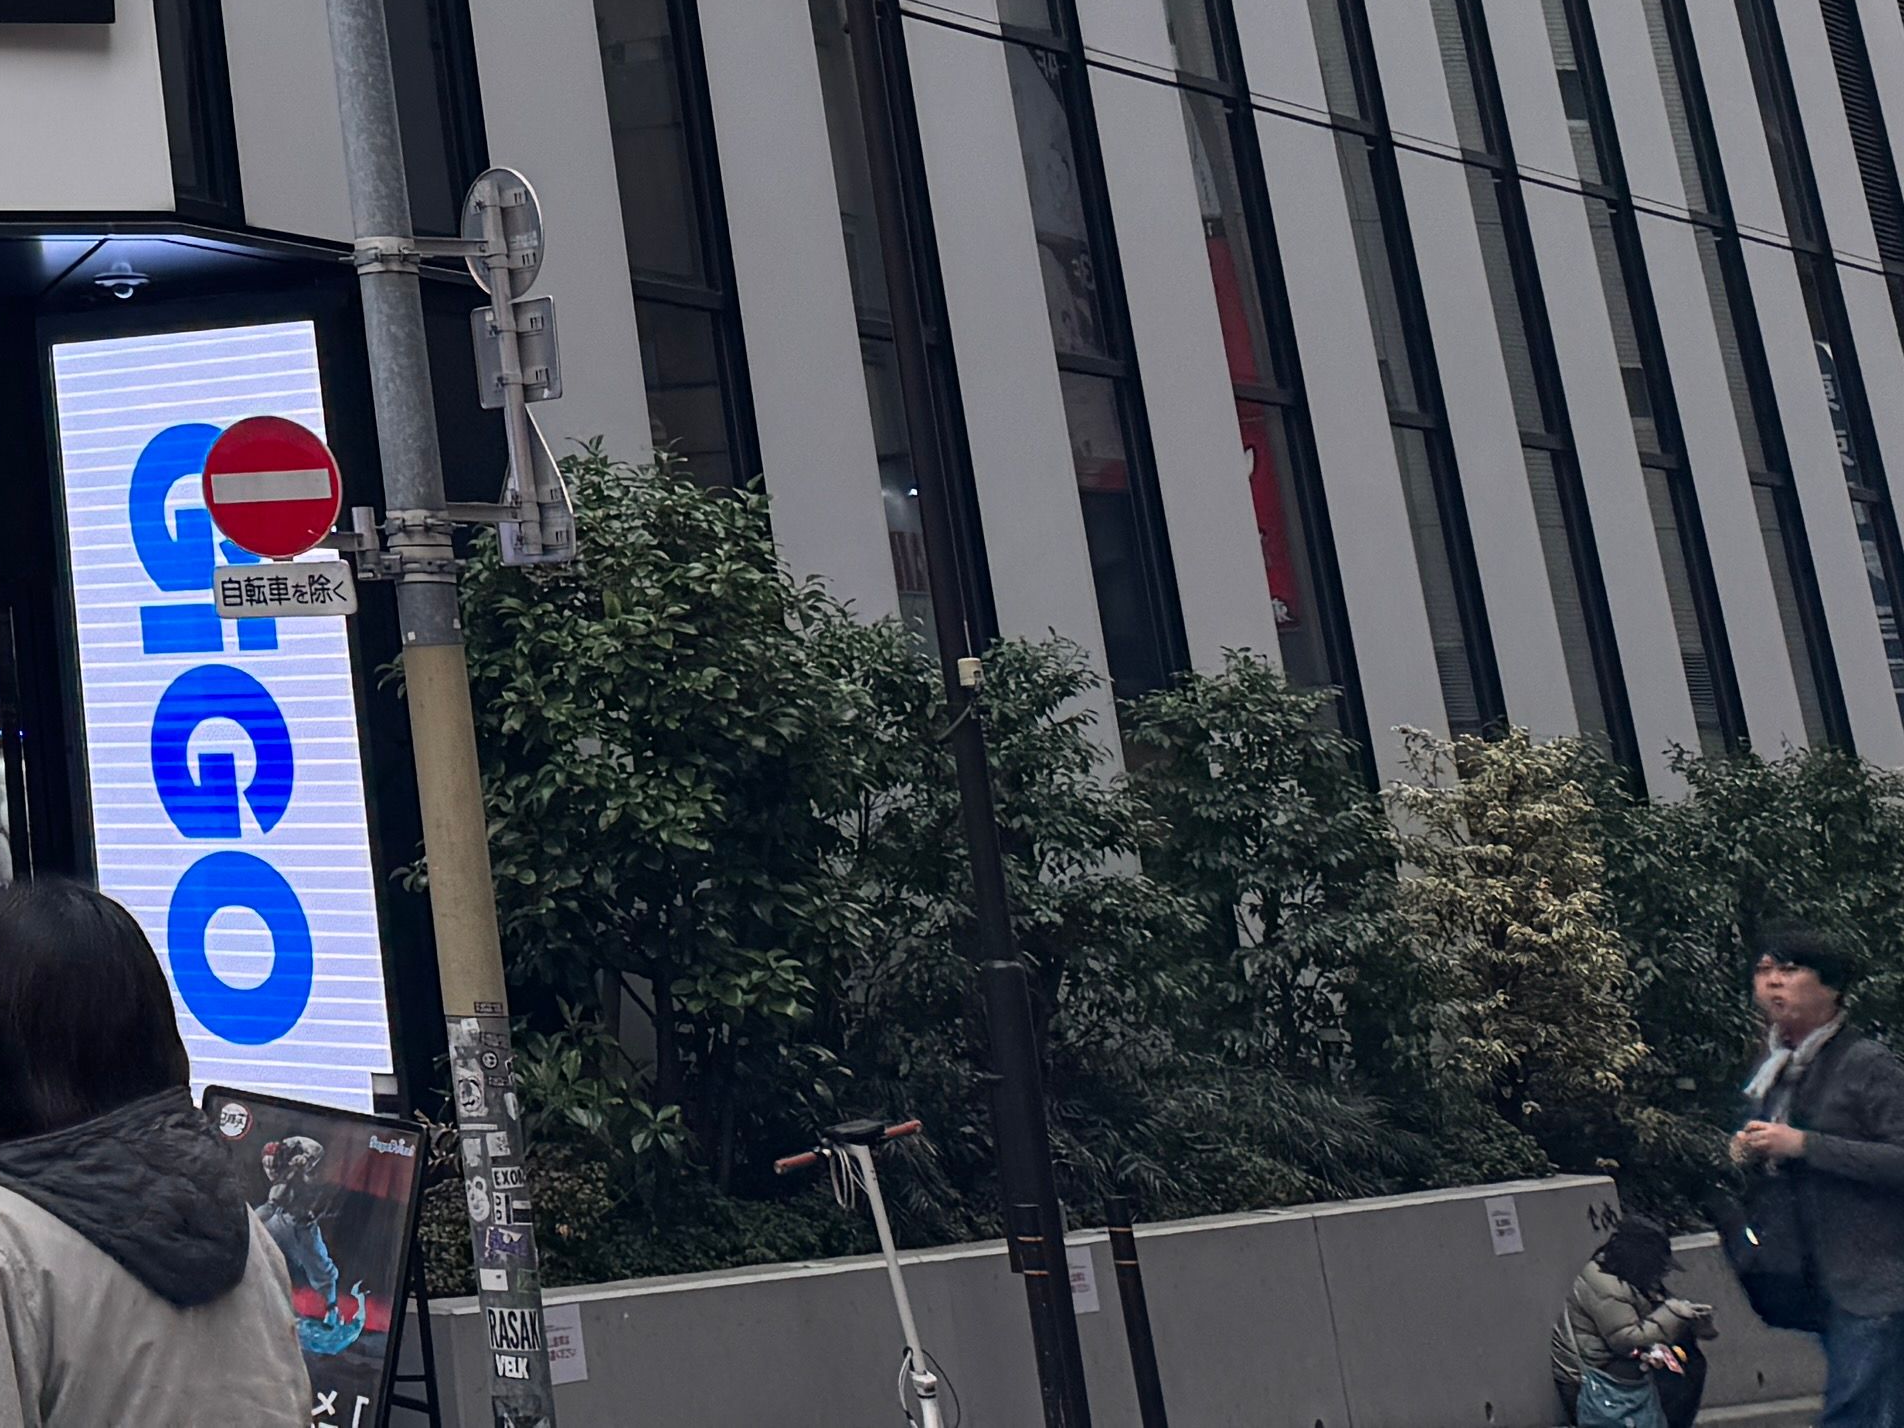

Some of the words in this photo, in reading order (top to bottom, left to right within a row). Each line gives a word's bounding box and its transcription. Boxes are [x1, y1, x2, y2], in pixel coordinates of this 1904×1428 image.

[221, 574, 347, 606] 自転車を除く
